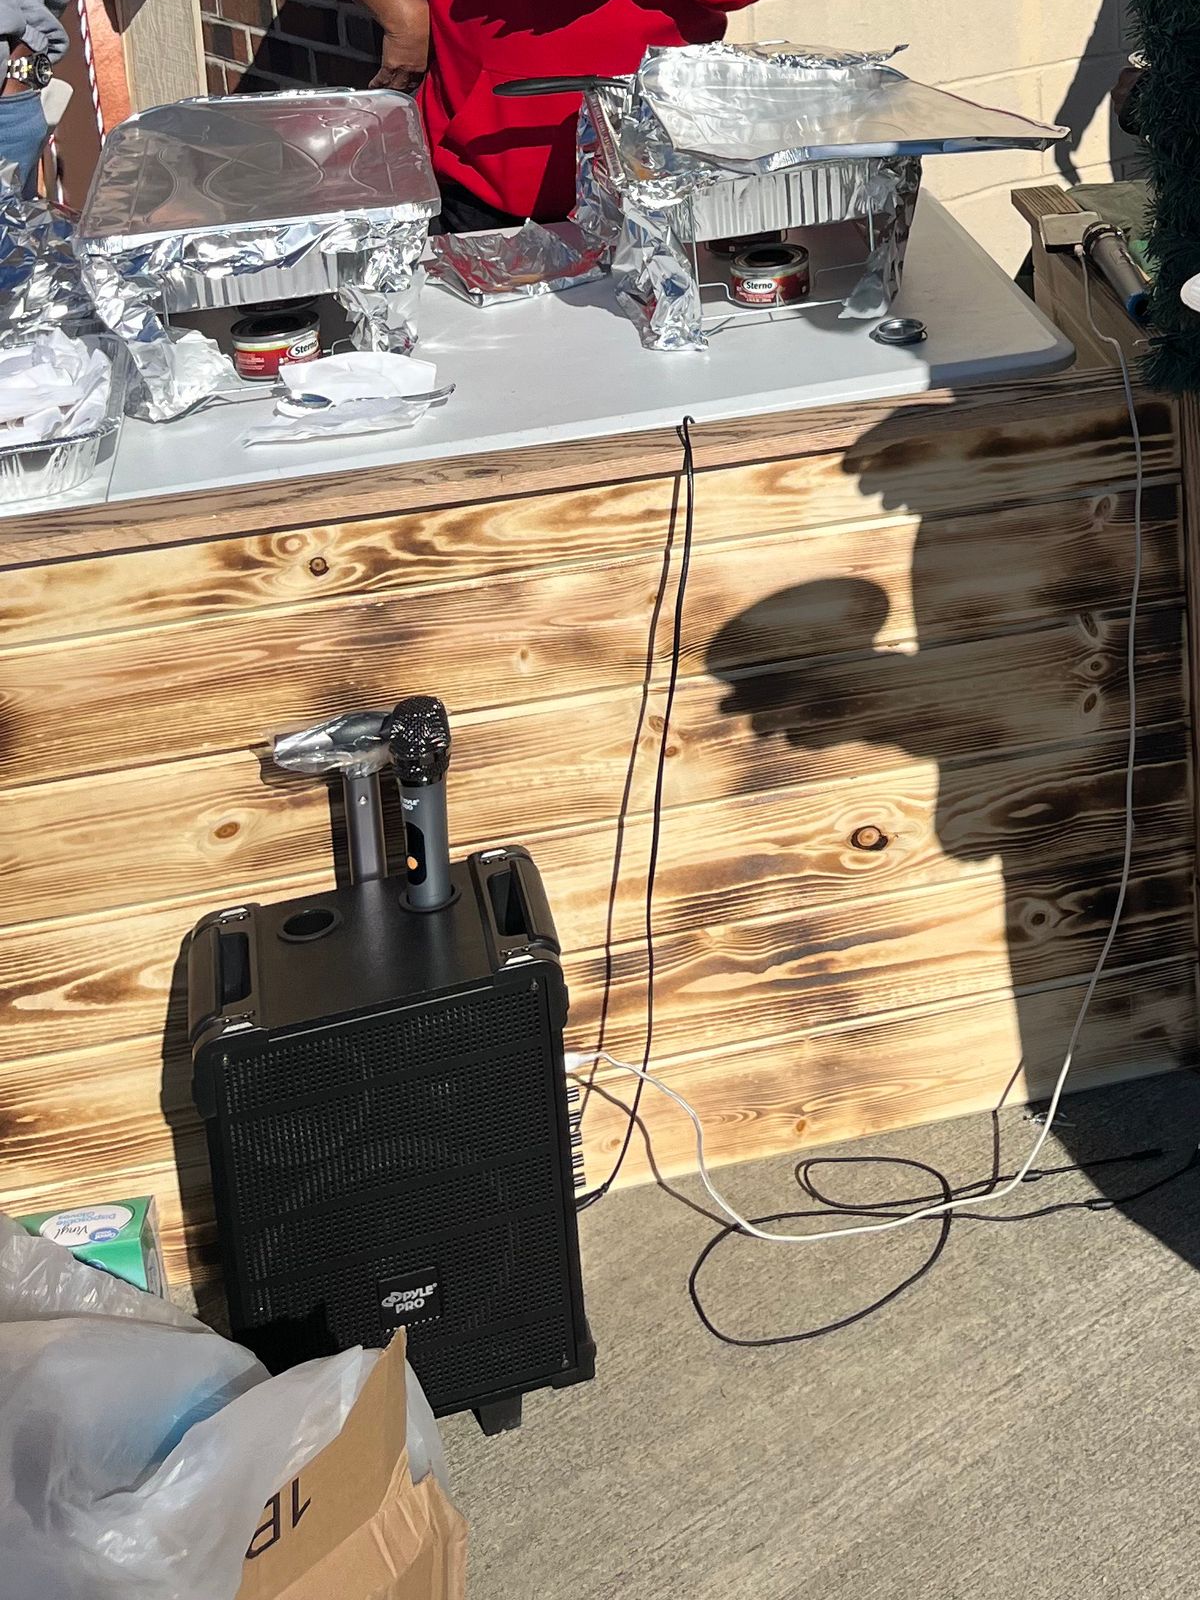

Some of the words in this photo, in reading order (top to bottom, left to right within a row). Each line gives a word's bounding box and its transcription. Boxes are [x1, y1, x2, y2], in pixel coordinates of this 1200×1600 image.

[746, 281, 773, 290] Sterno
[295, 340, 318, 356] Sterno
[53, 1225, 88, 1240] Vinyl
[402, 1285, 434, 1302] PYLE
[395, 1298, 425, 1314] PRO
